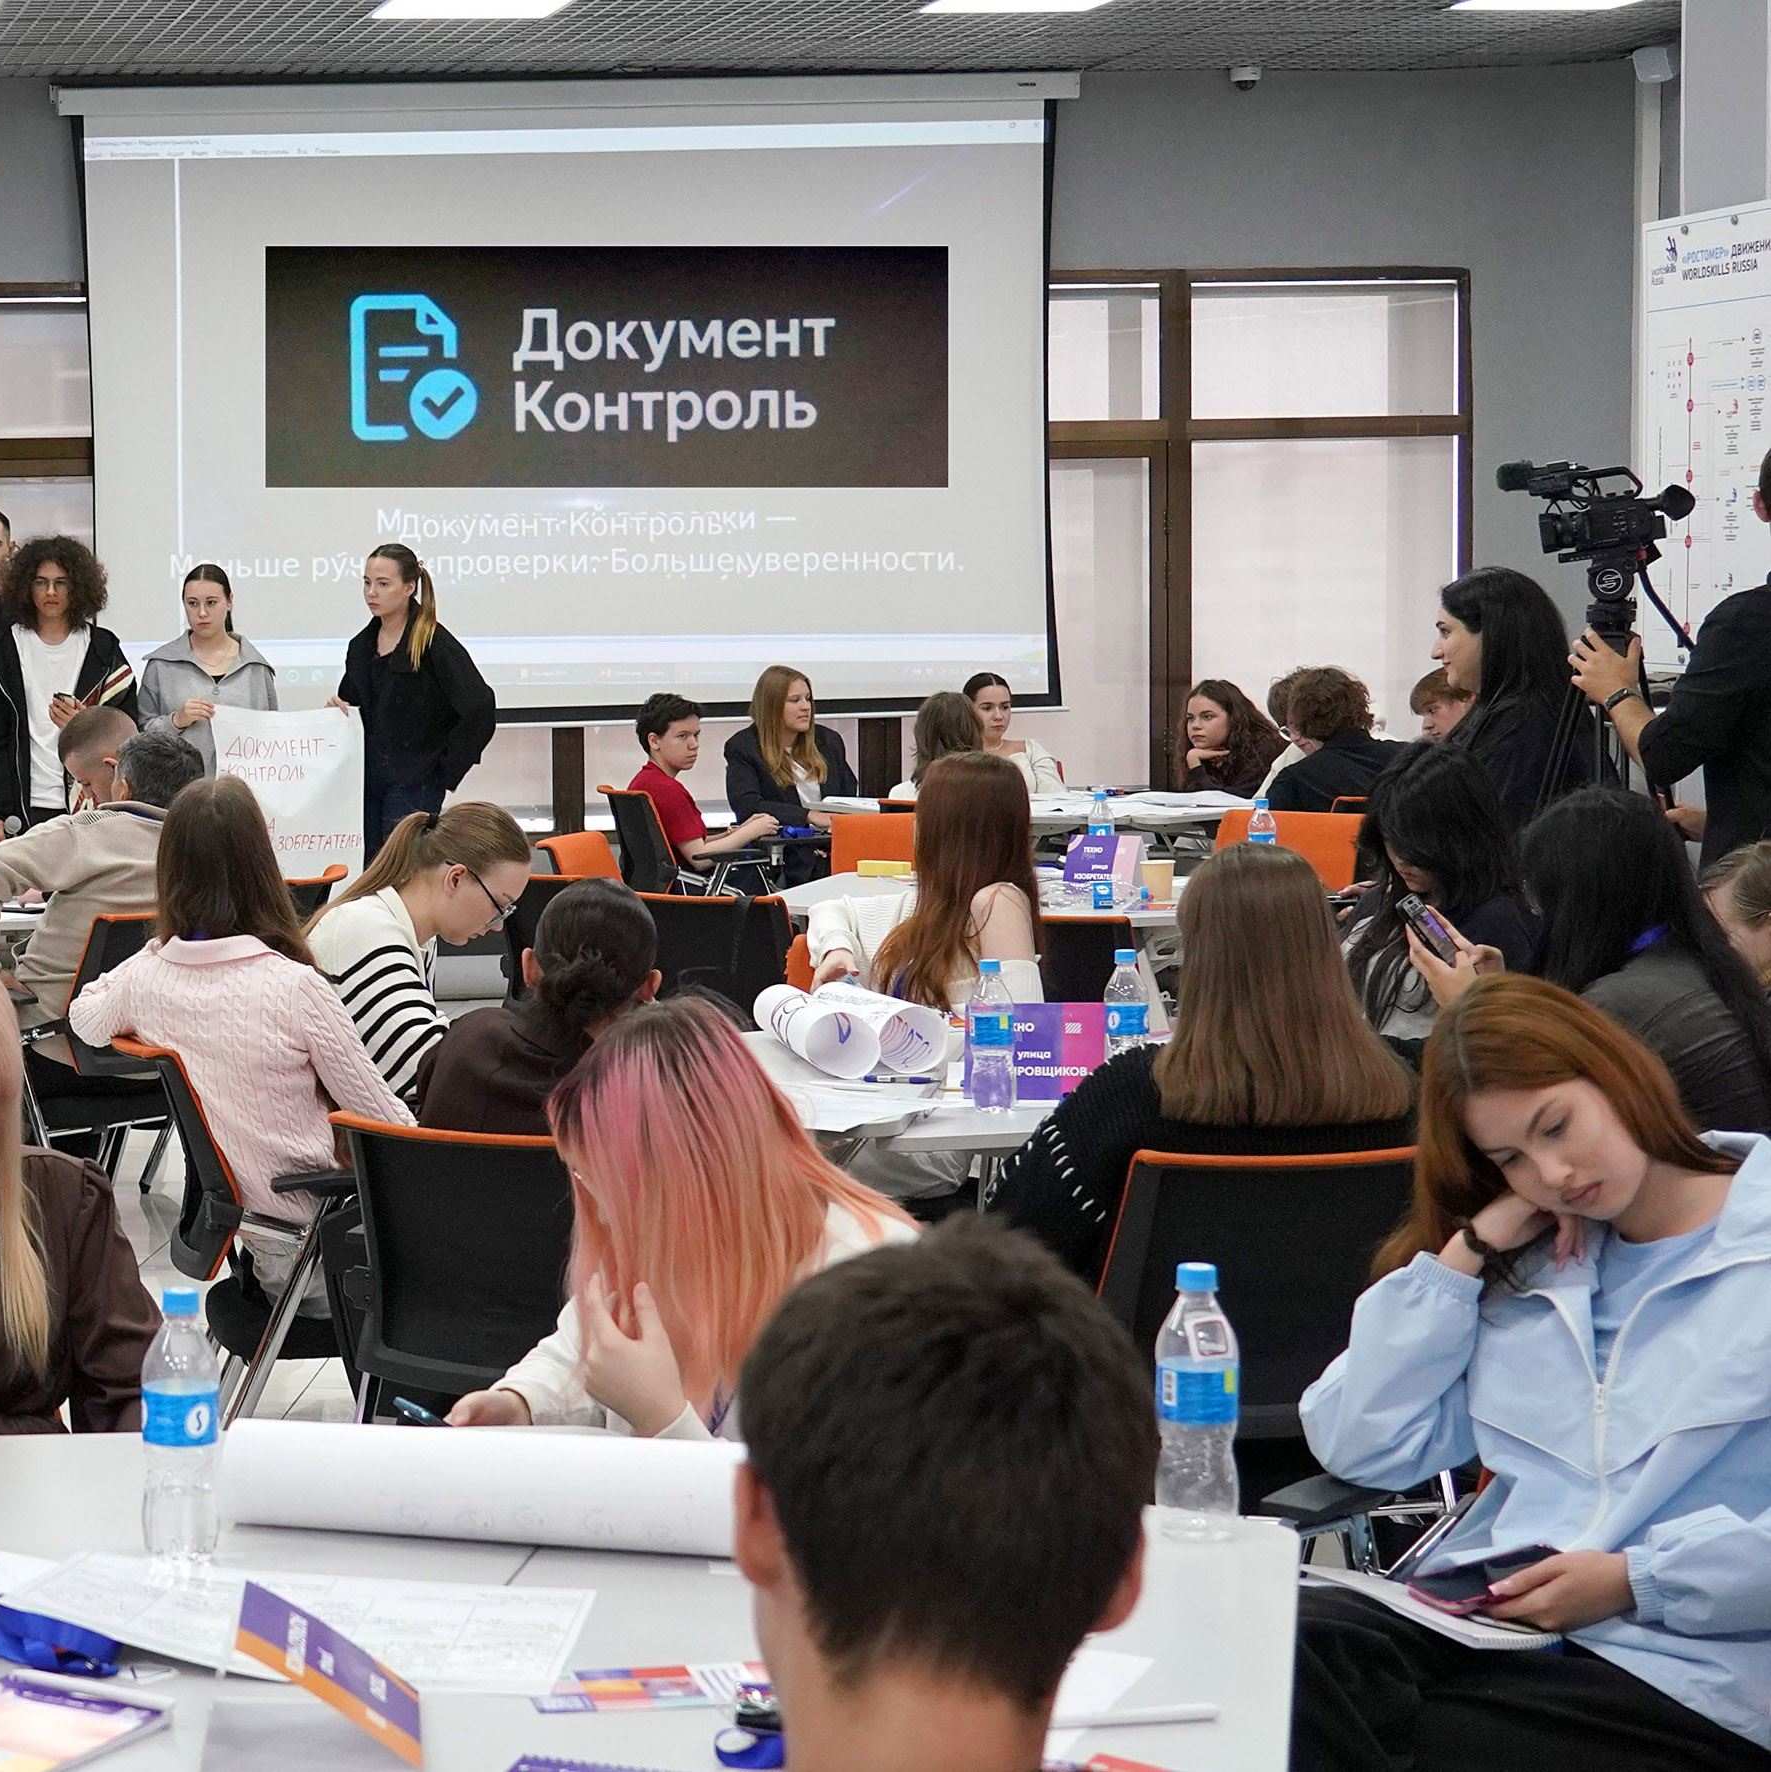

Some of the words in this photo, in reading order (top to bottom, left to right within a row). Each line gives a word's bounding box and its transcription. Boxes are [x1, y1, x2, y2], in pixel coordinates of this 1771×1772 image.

[1681, 246, 1730, 264] «РОСТОМЕР»
[1731, 239, 1771, 259] ДВИЖЕНИ
[1682, 262, 1730, 282] WORLDSKILLS
[1732, 258, 1758, 273] RUSSIA
[512, 307, 837, 372] Документ
[513, 381, 819, 442] Контроль
[169, 554, 301, 578] Мньше
[743, 550, 965, 580] уверенности.
[1083, 846, 1104, 854] ТЕХНО
[1016, 1050, 1052, 1060] улица
